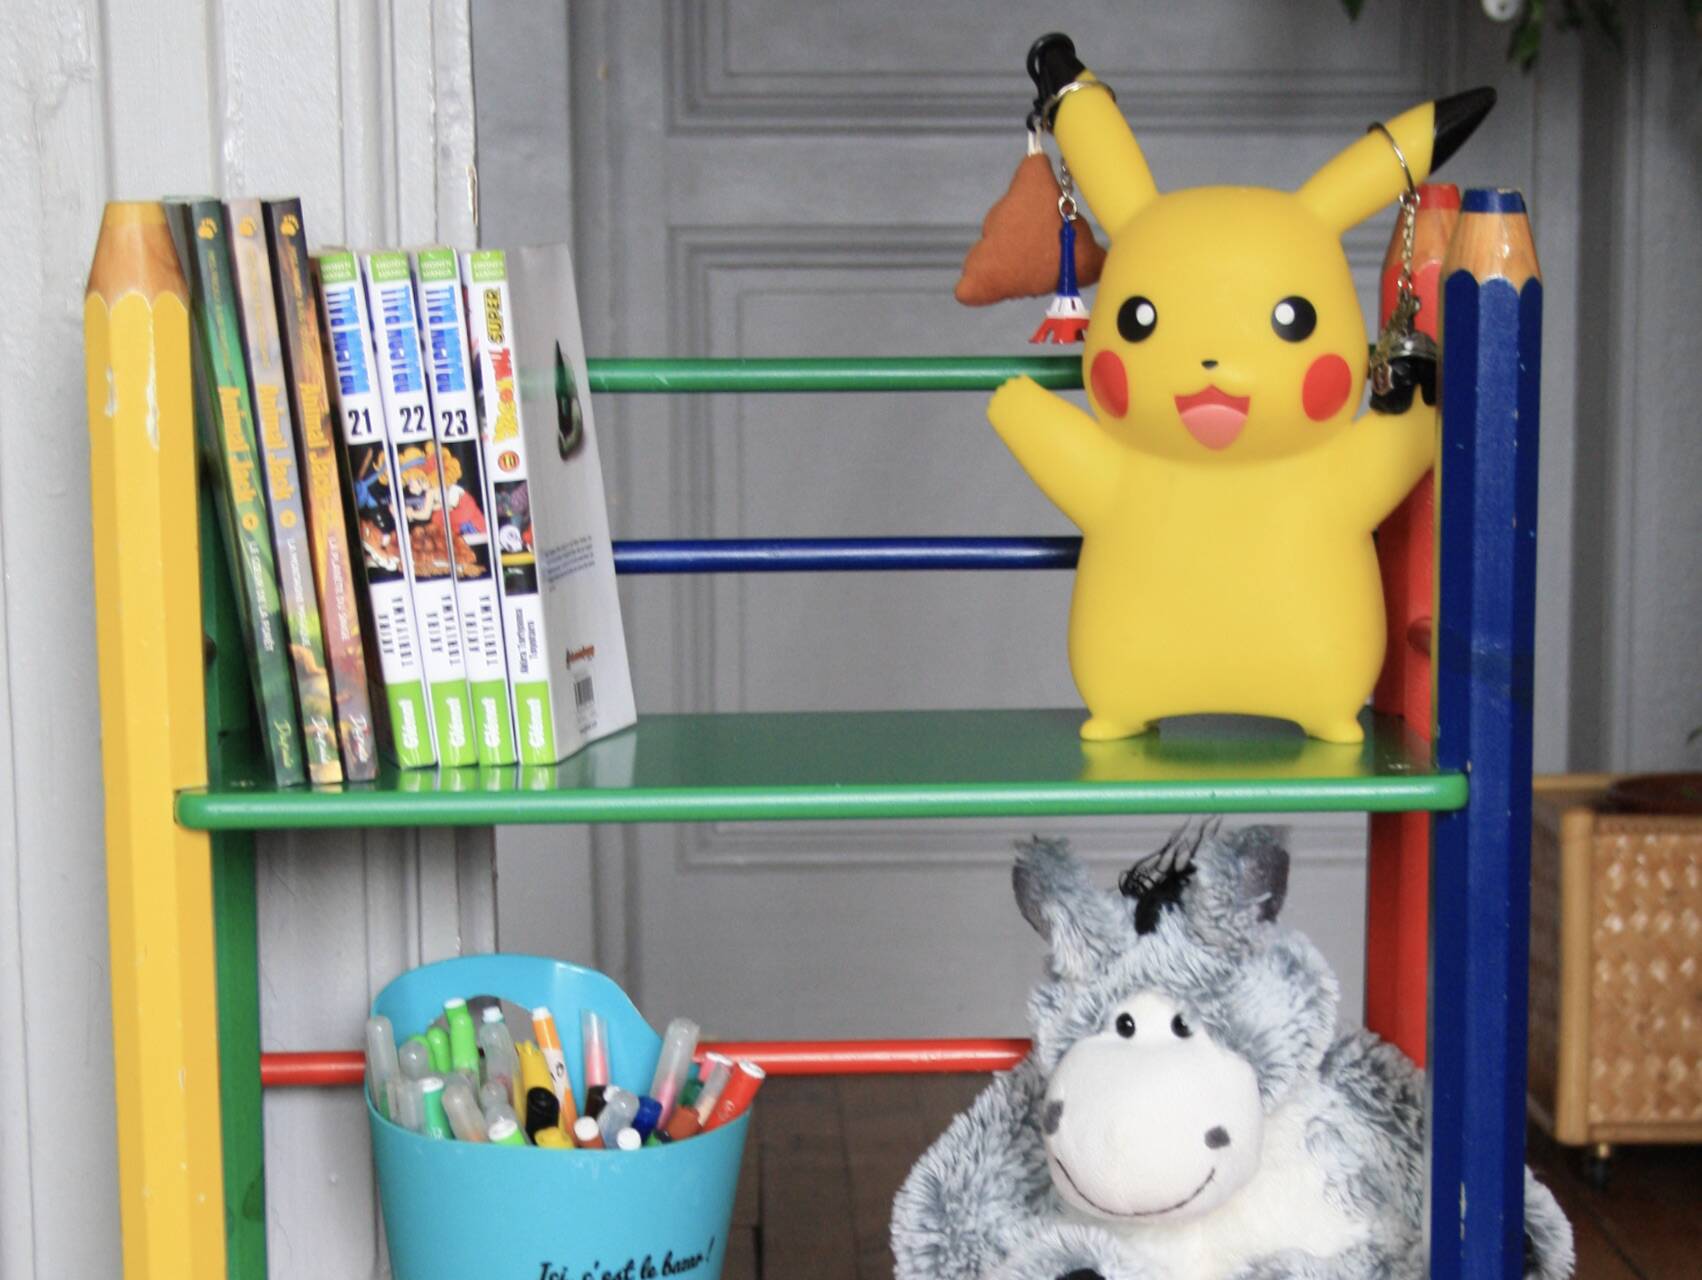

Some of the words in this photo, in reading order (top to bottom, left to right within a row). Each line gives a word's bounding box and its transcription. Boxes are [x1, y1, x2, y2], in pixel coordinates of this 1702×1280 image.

[326, 286, 359, 326] BALL
[381, 284, 414, 325] BALL
[426, 284, 457, 325] BALL
[484, 286, 505, 344] SUPER
[333, 329, 370, 395] DRAGON
[387, 328, 422, 393] DRAGON
[431, 328, 465, 393] DRAGON
[218, 386, 250, 452] Animal
[258, 384, 289, 448] Animal
[299, 383, 330, 448] Animal
[348, 408, 372, 436] 21
[400, 405, 427, 433] 22
[442, 409, 468, 437] 23
[492, 378, 519, 443] DRAGON
[229, 454, 256, 502] Jack
[269, 452, 294, 501] Jack
[378, 614, 394, 653] AKIRA
[392, 597, 413, 667] TORIYAMA
[427, 613, 443, 652] AKIRA
[441, 596, 460, 666] TORIYAMA
[465, 613, 480, 652] AKIRA
[480, 596, 498, 666] TORIYAMA
[640, 1253, 657, 1280] le
